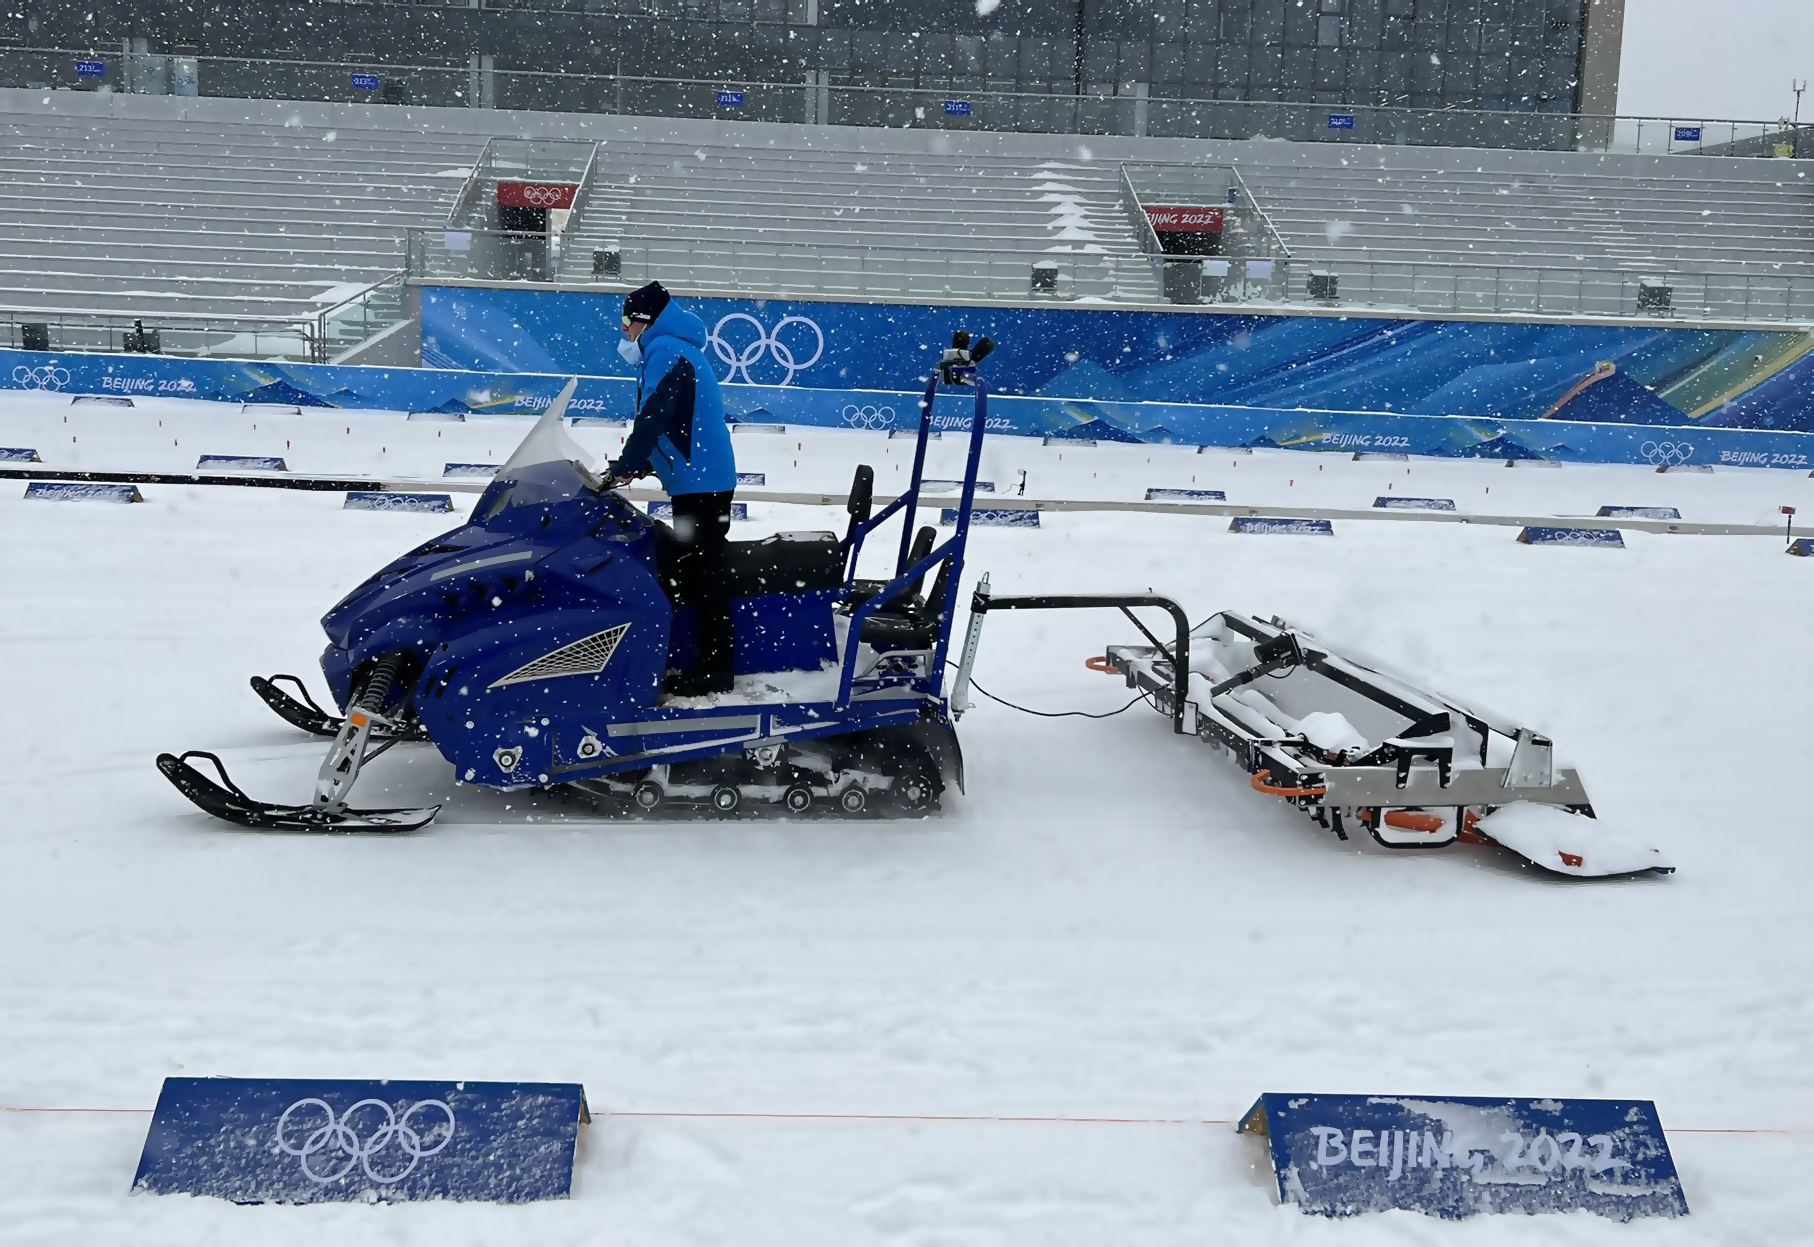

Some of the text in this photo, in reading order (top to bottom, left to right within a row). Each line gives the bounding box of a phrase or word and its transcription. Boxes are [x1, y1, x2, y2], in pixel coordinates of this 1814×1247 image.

[1146, 213, 1214, 225] IJING 2022
[101, 376, 197, 392] BEIJING 2022
[514, 395, 608, 412] BEIJIN 2022
[984, 417, 1013, 429] 022
[1321, 432, 1411, 448] BEIJING 2022
[1720, 450, 1808, 466] BEIJING 2022
[1309, 1126, 1634, 1181] BEIJING 2022
